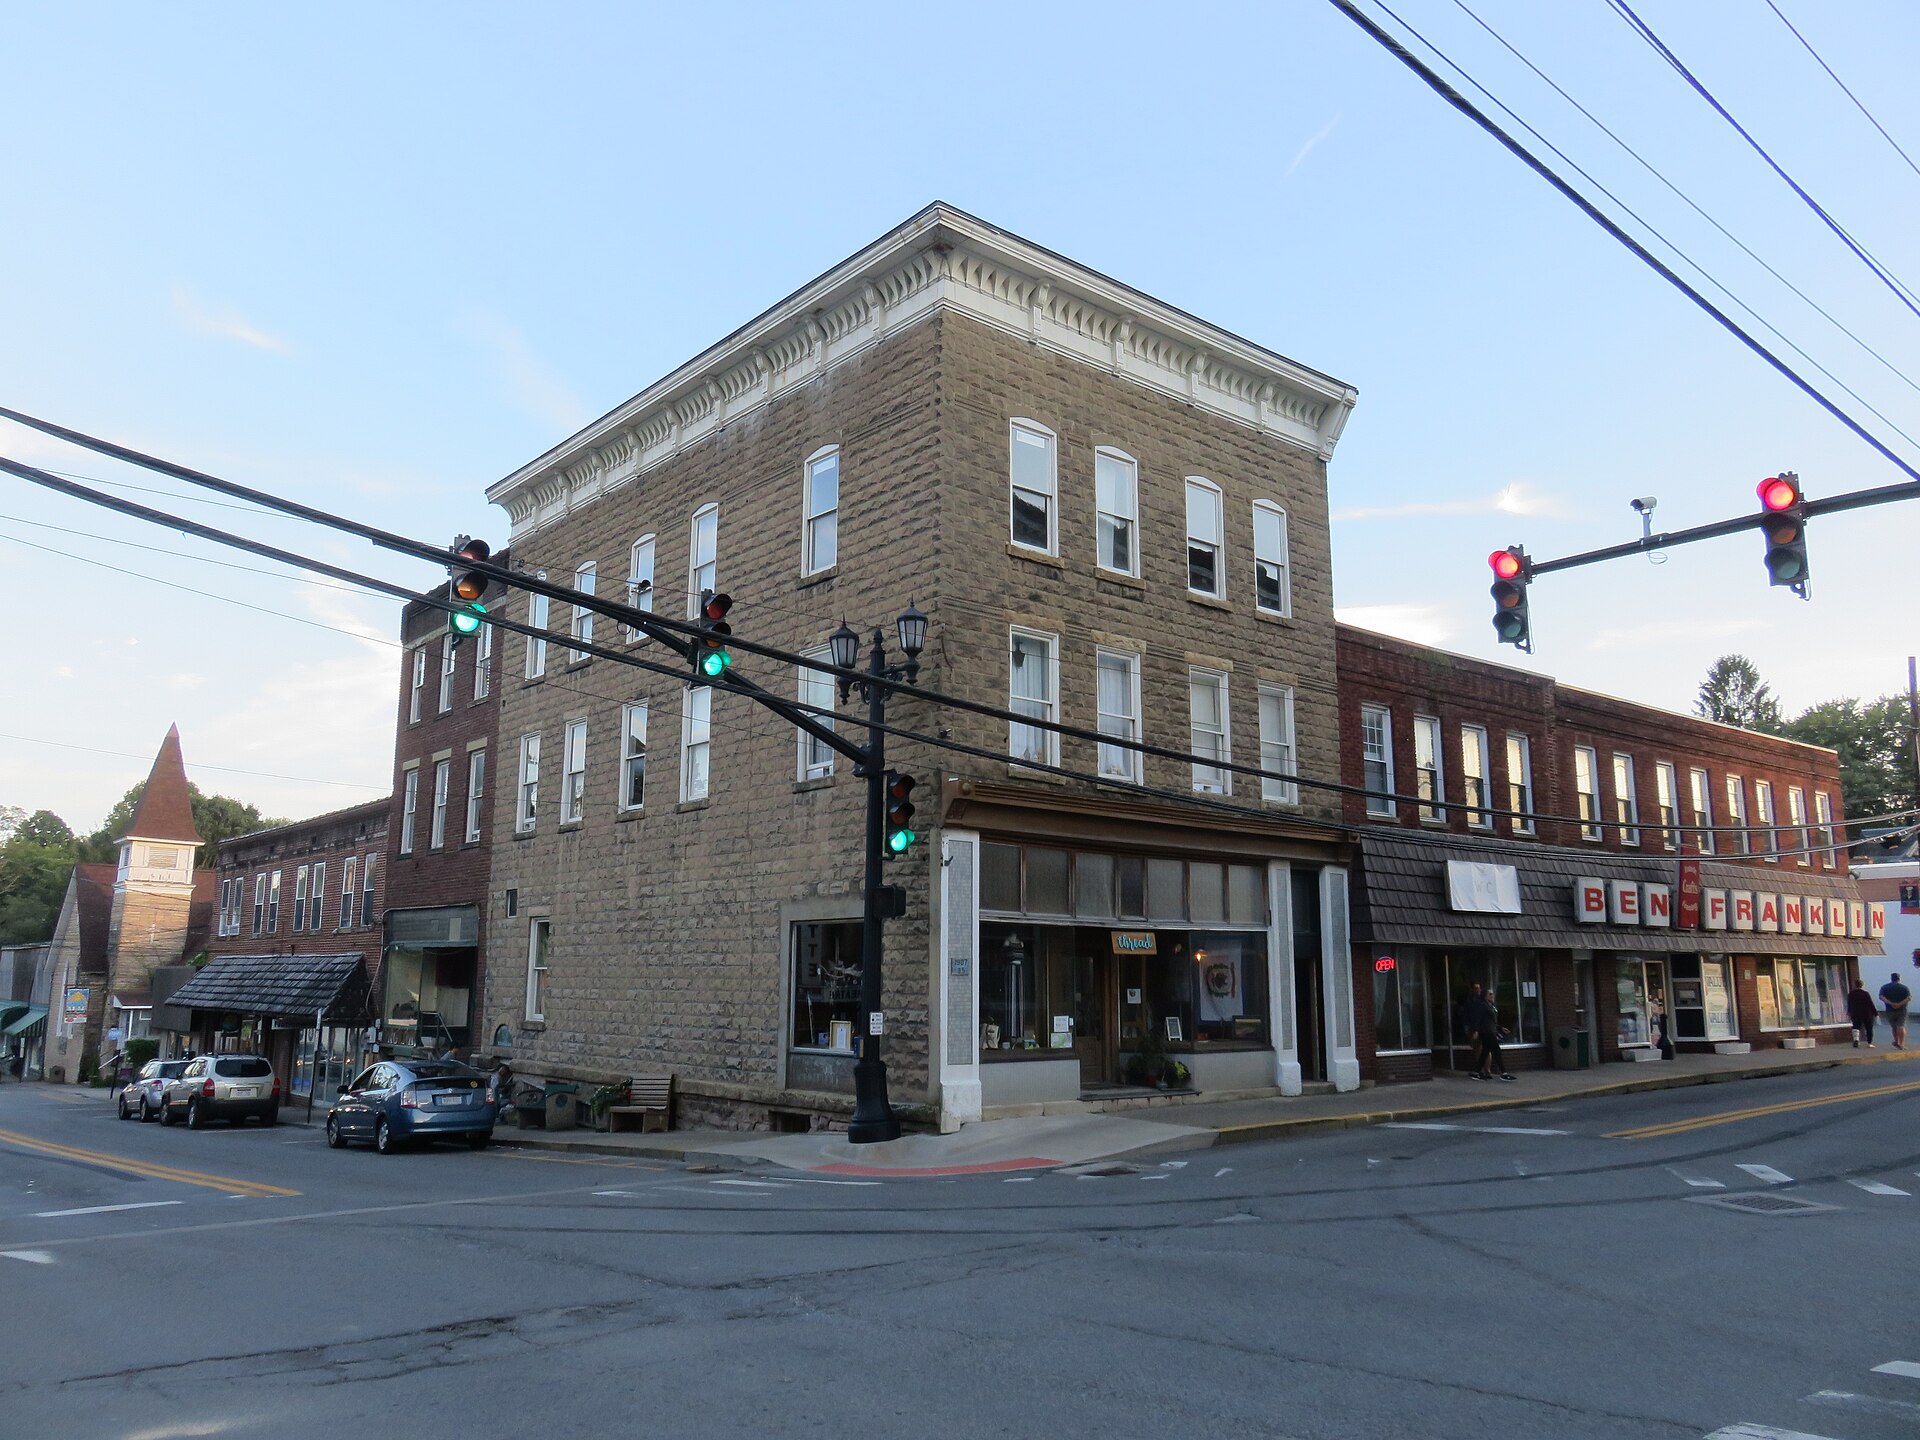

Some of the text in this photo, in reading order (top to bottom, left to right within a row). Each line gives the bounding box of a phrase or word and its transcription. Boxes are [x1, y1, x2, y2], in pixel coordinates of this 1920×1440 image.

[1584, 887, 1884, 929] BEN FRANKLIN
[1117, 933, 1152, 951] thread
[1375, 959, 1395, 971] OPEN
